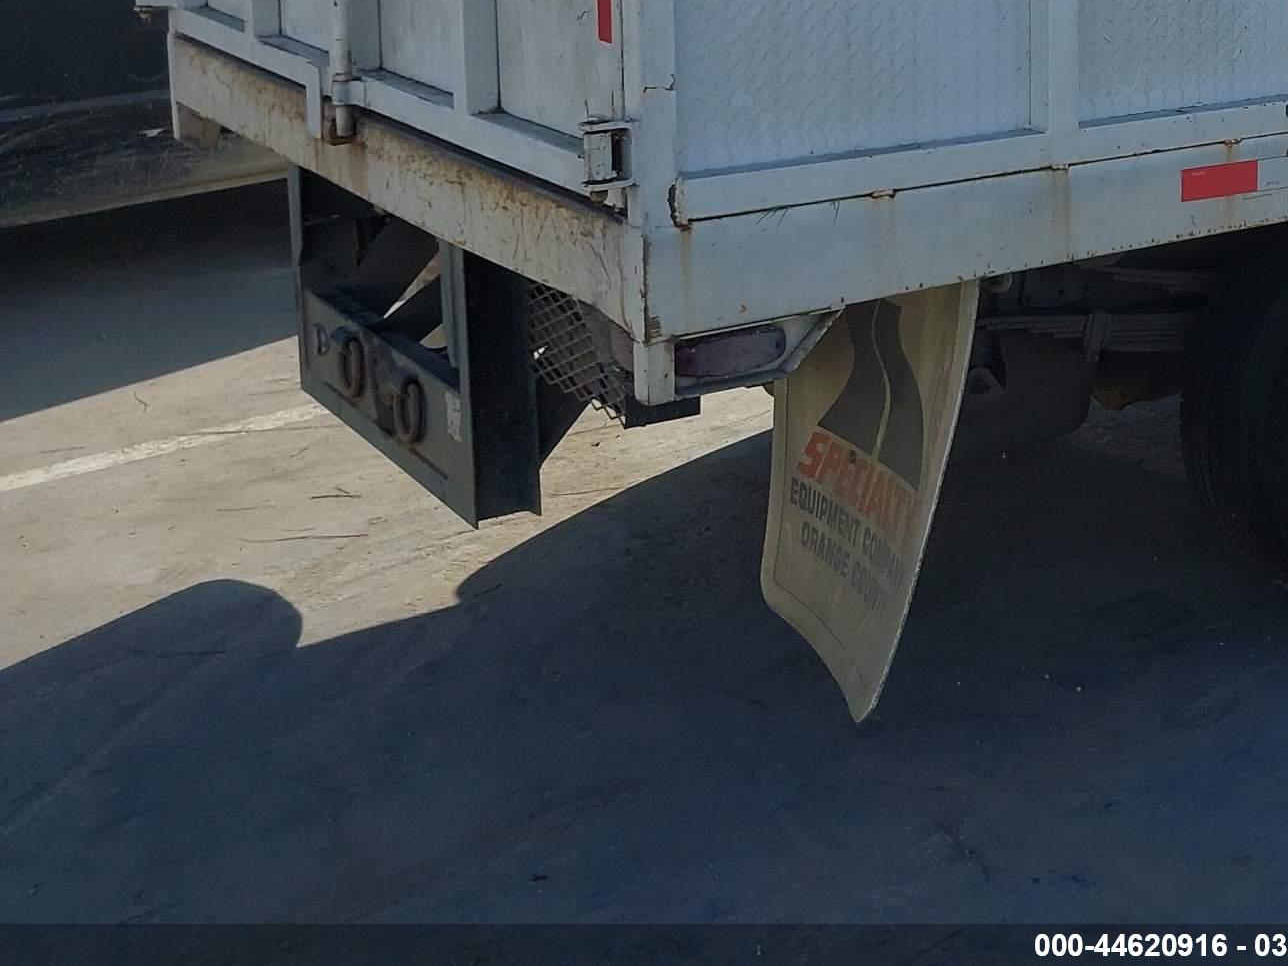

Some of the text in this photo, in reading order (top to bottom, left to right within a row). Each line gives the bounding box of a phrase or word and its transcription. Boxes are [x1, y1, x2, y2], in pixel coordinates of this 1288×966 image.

[790, 477, 861, 547] EQUIPMENT
[798, 431, 918, 554] SPECIALTY
[800, 521, 850, 579] ORANGE
